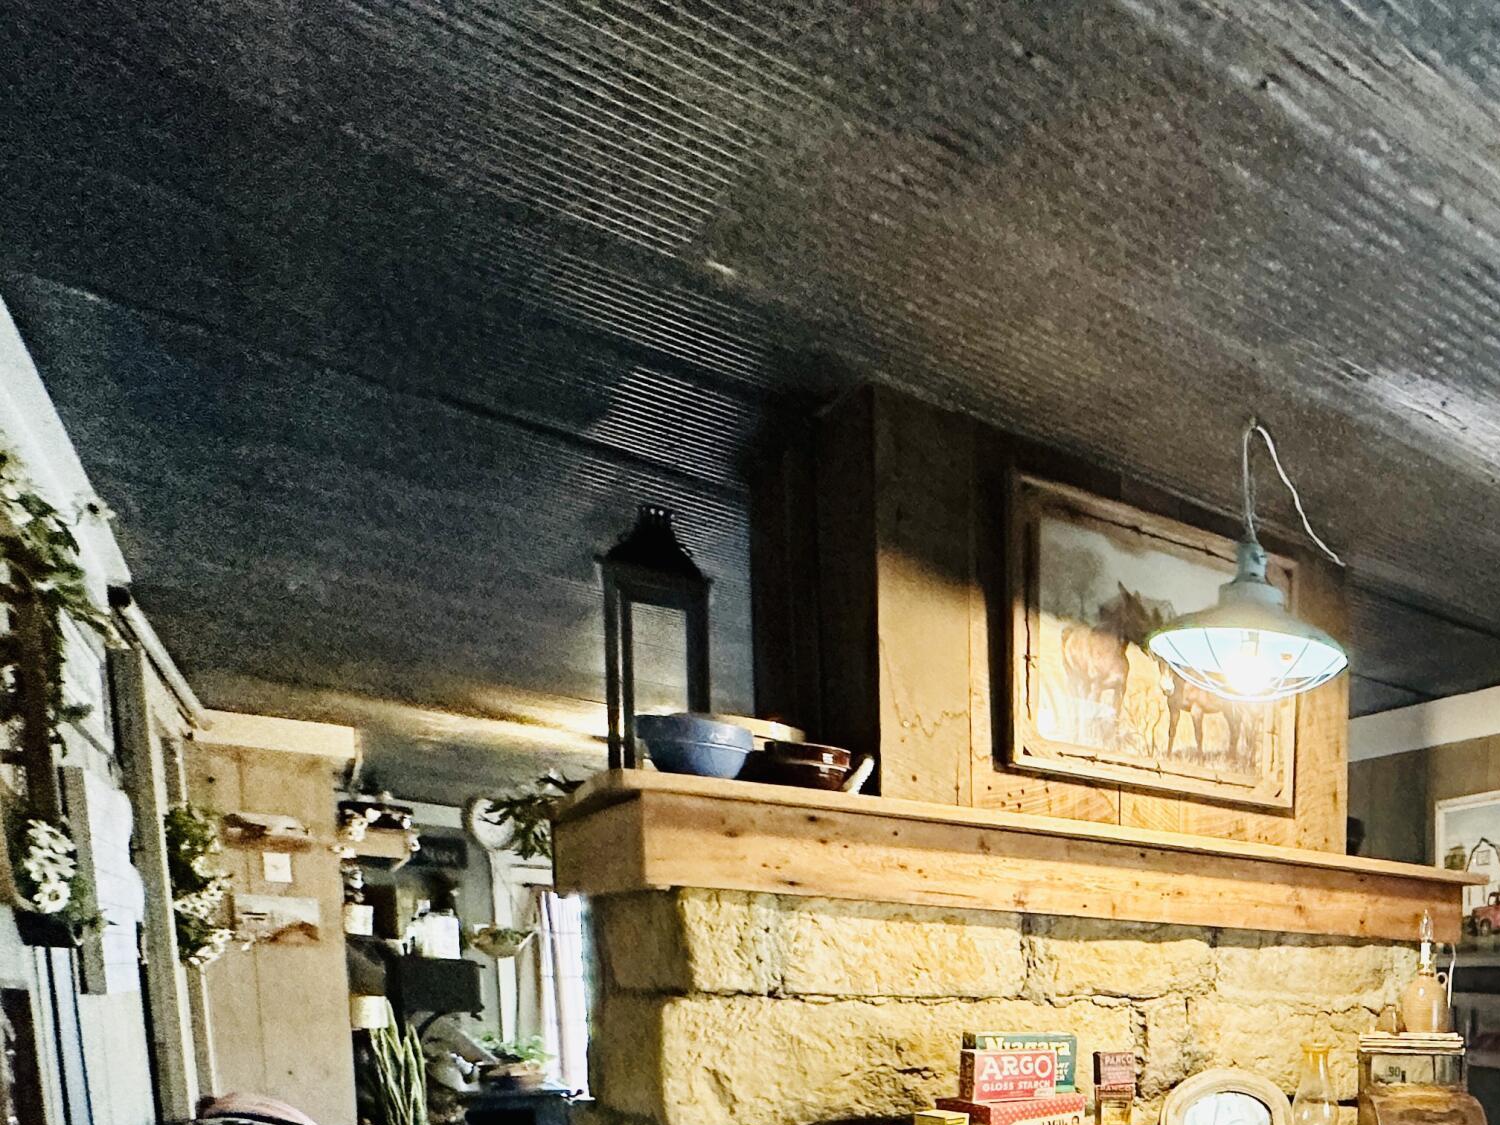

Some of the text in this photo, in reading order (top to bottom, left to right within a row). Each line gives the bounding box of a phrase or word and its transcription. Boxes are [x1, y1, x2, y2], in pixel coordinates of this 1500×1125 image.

[979, 1055, 1052, 1081] ARGO
[982, 1080, 1051, 1092] GLOSS STARCH
